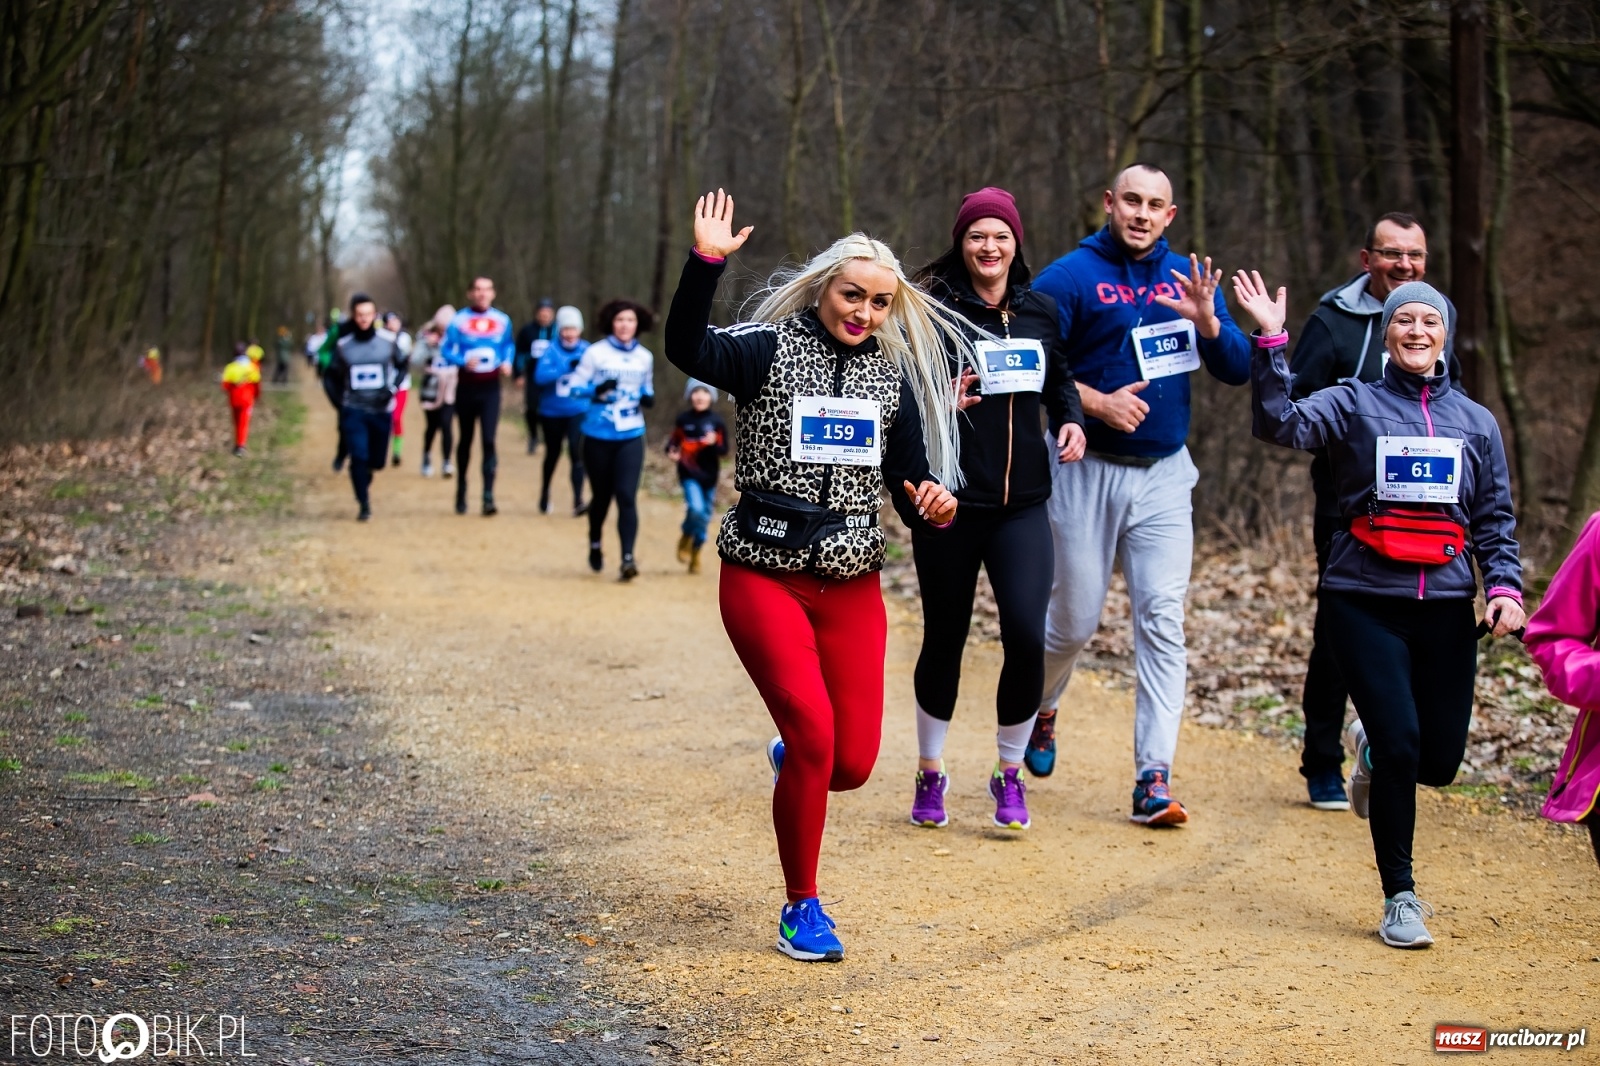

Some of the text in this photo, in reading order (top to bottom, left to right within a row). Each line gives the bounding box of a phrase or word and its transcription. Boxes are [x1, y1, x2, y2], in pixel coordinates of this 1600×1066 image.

[1154, 337, 1178, 353] 160
[1005, 354, 1023, 367] 62
[823, 423, 855, 441] 159
[1411, 461, 1433, 478] 61
[759, 516, 788, 531] GYM
[845, 514, 870, 528] GYM
[756, 525, 786, 538] HARD
